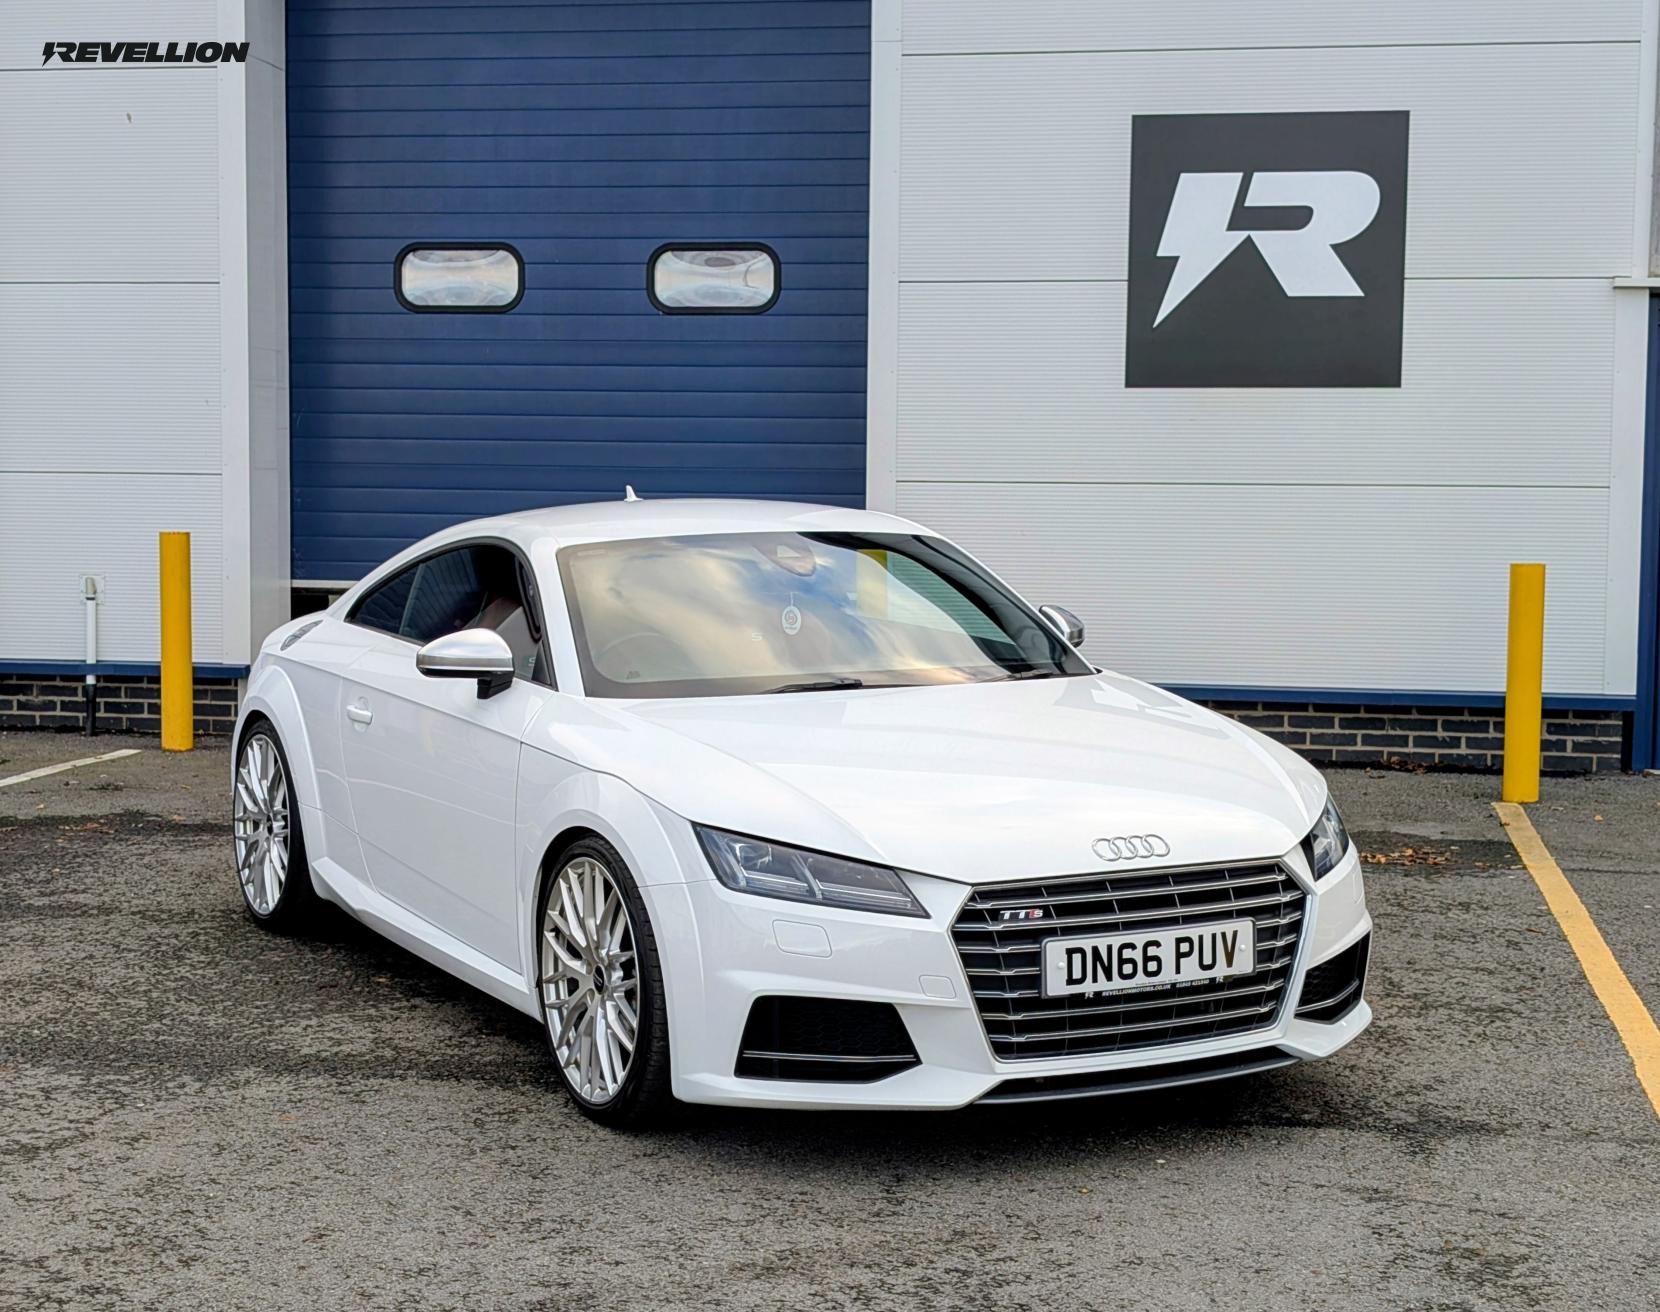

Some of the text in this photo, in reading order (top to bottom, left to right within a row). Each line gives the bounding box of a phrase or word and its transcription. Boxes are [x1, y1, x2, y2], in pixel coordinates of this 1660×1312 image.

[1152, 170, 1381, 329] R
[1000, 909, 1043, 920] TTS
[1065, 929, 1239, 986] DN66 PUV
